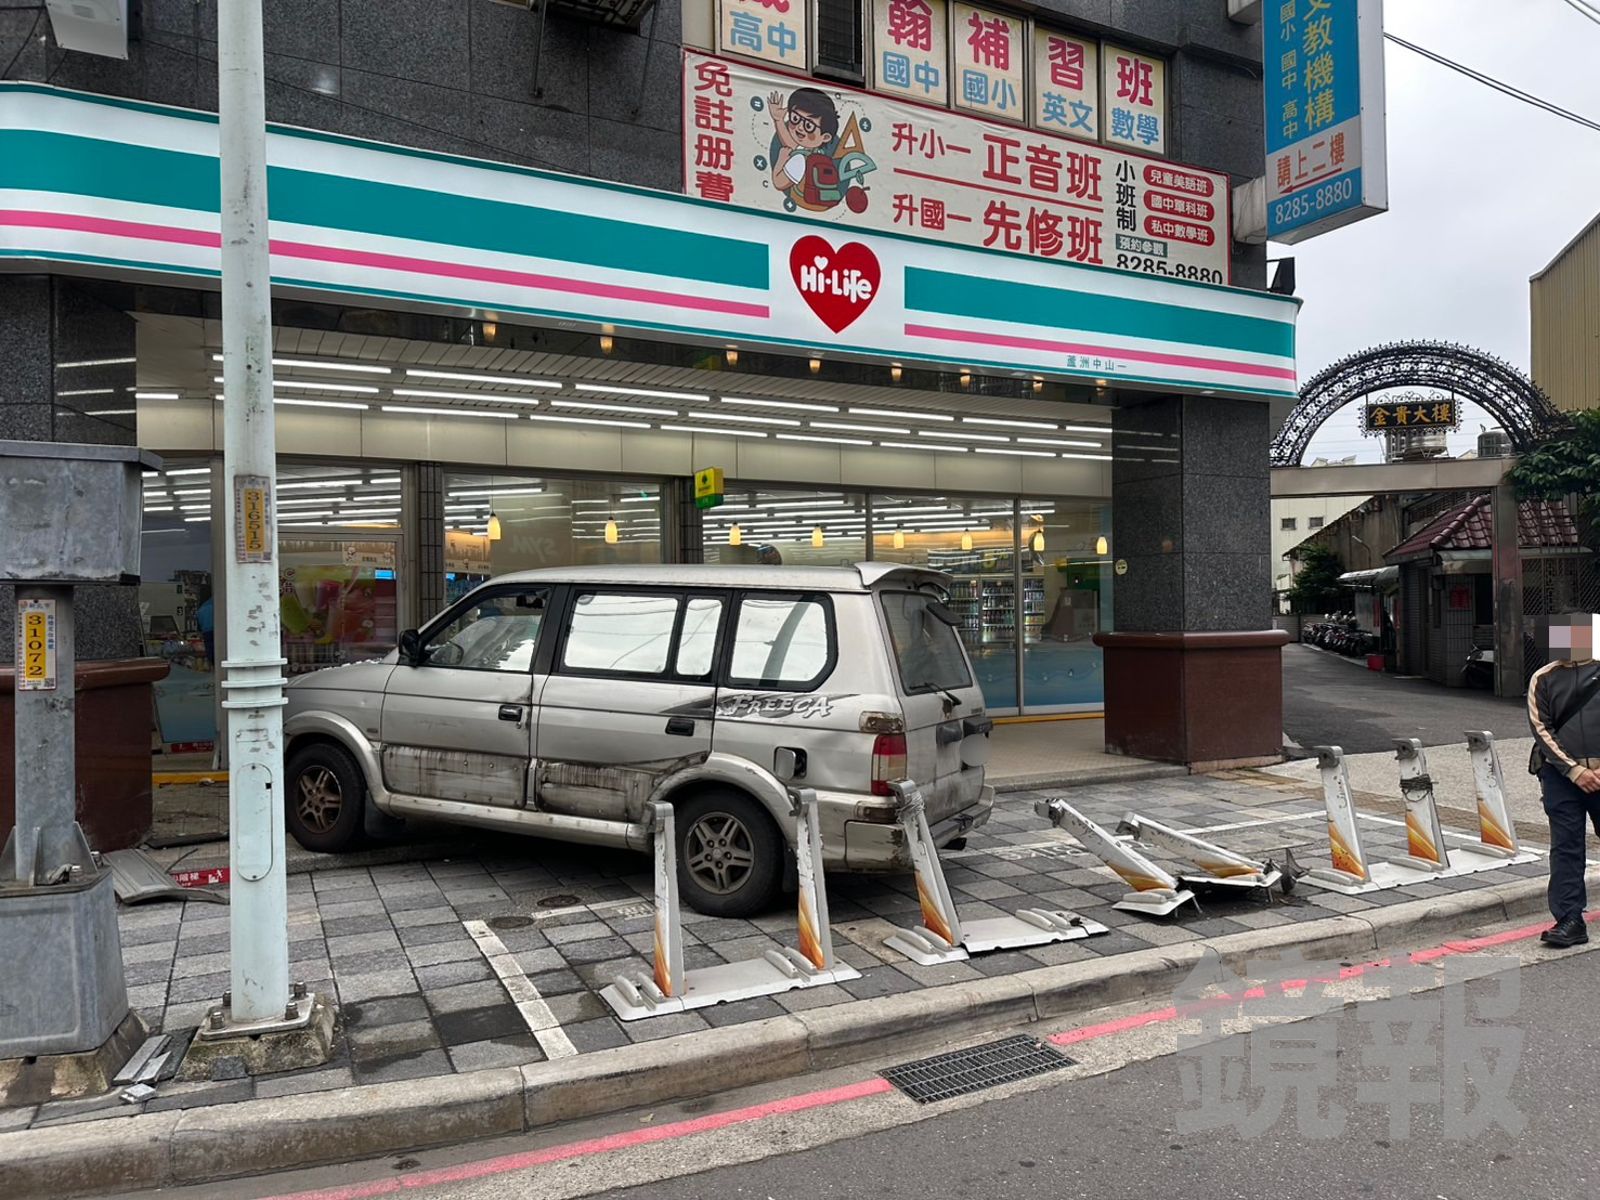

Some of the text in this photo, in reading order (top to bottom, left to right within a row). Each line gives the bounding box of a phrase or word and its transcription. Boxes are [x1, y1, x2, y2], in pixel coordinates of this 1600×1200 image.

[730, 11, 1159, 146] 高中 國中 國小 英文 數學
[1280, 0, 1298, 139] 國小 國中 高中
[891, 123, 1103, 202] 升小一 正音班
[1277, 132, 1345, 188] 請上二樓
[1115, 160, 1137, 232] 小班制
[1275, 178, 1352, 224] 8285-8880
[892, 194, 1103, 265] 升國一 先修班
[1150, 219, 1209, 243] 私中數學班
[1116, 253, 1223, 285] 8285-8880
[247, 491, 262, 549] 316515
[28, 614, 43, 676] 31072
[731, 694, 835, 718] FREECA
